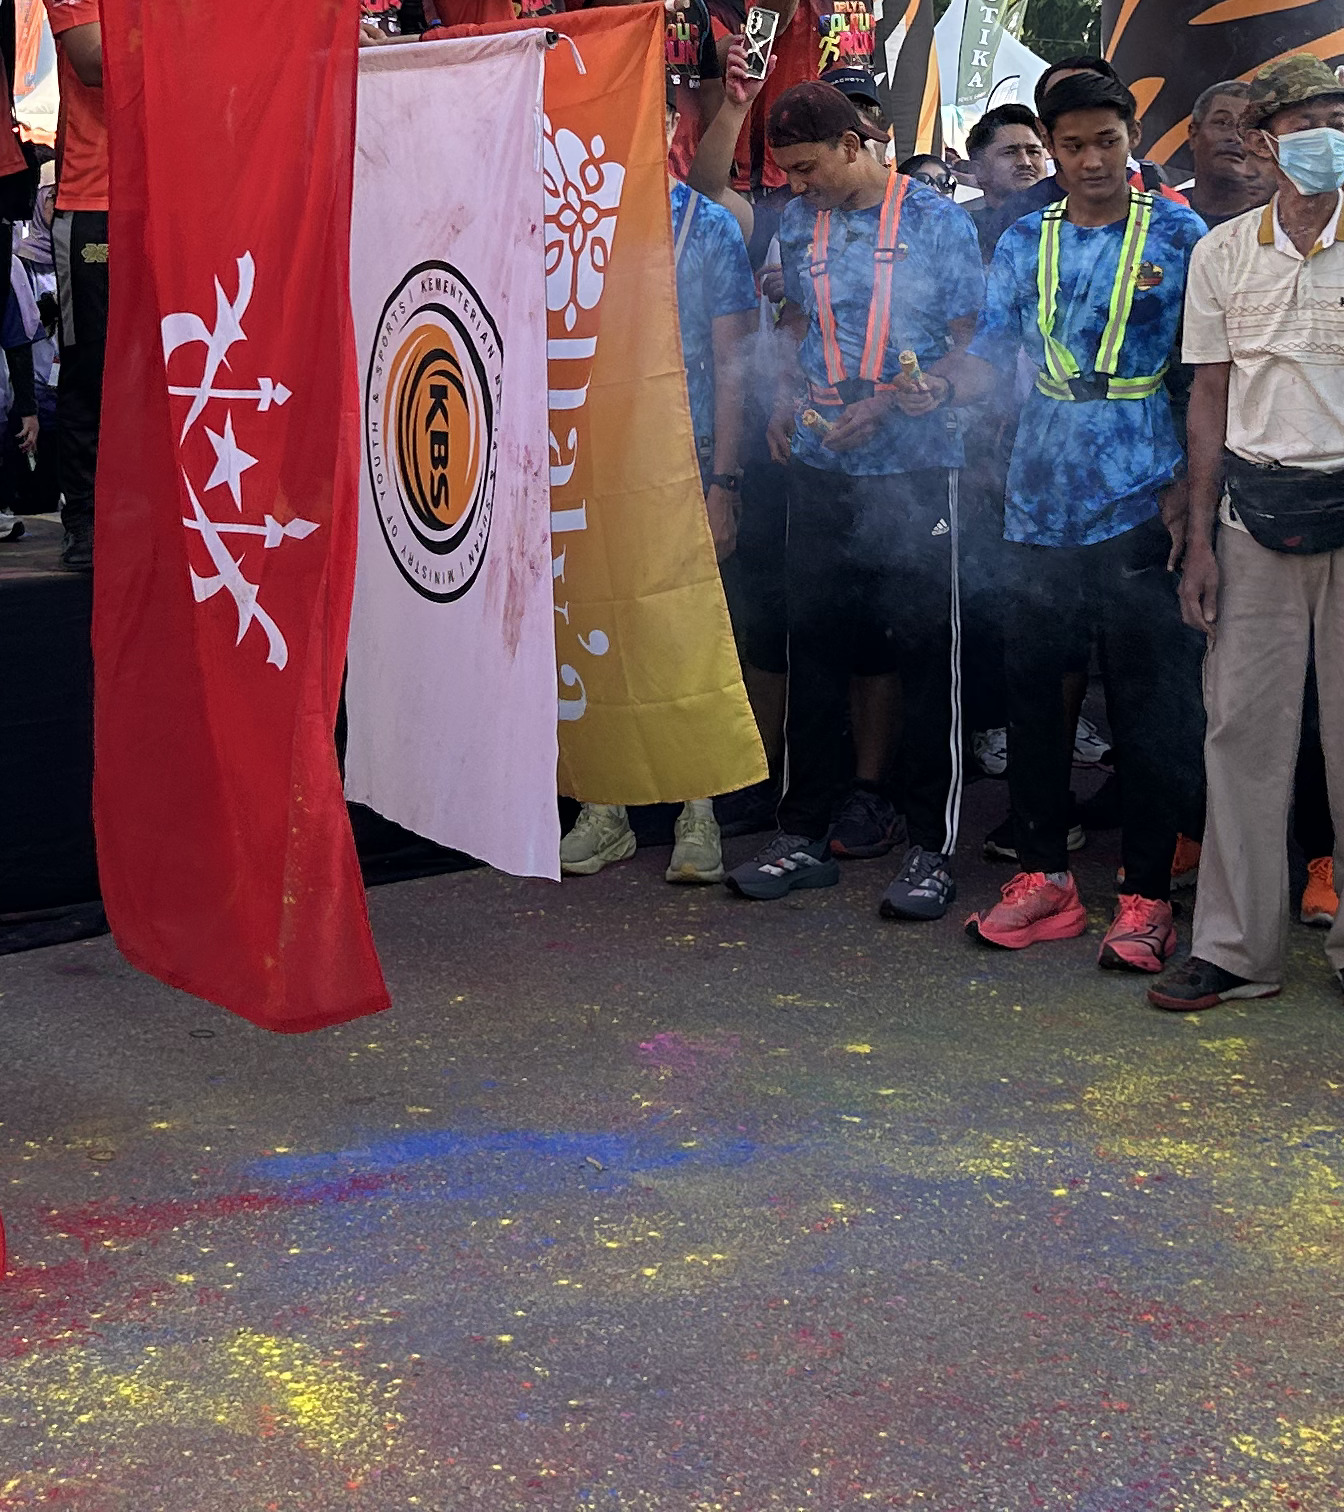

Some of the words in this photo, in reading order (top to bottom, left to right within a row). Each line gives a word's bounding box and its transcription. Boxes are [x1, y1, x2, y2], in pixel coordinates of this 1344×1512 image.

[374, 301, 406, 375] SPORTS
[371, 421, 386, 501] YOUTH
[424, 384, 450, 511] KBS
[385, 516, 399, 539] OF
[399, 546, 454, 587] MINISTRY
